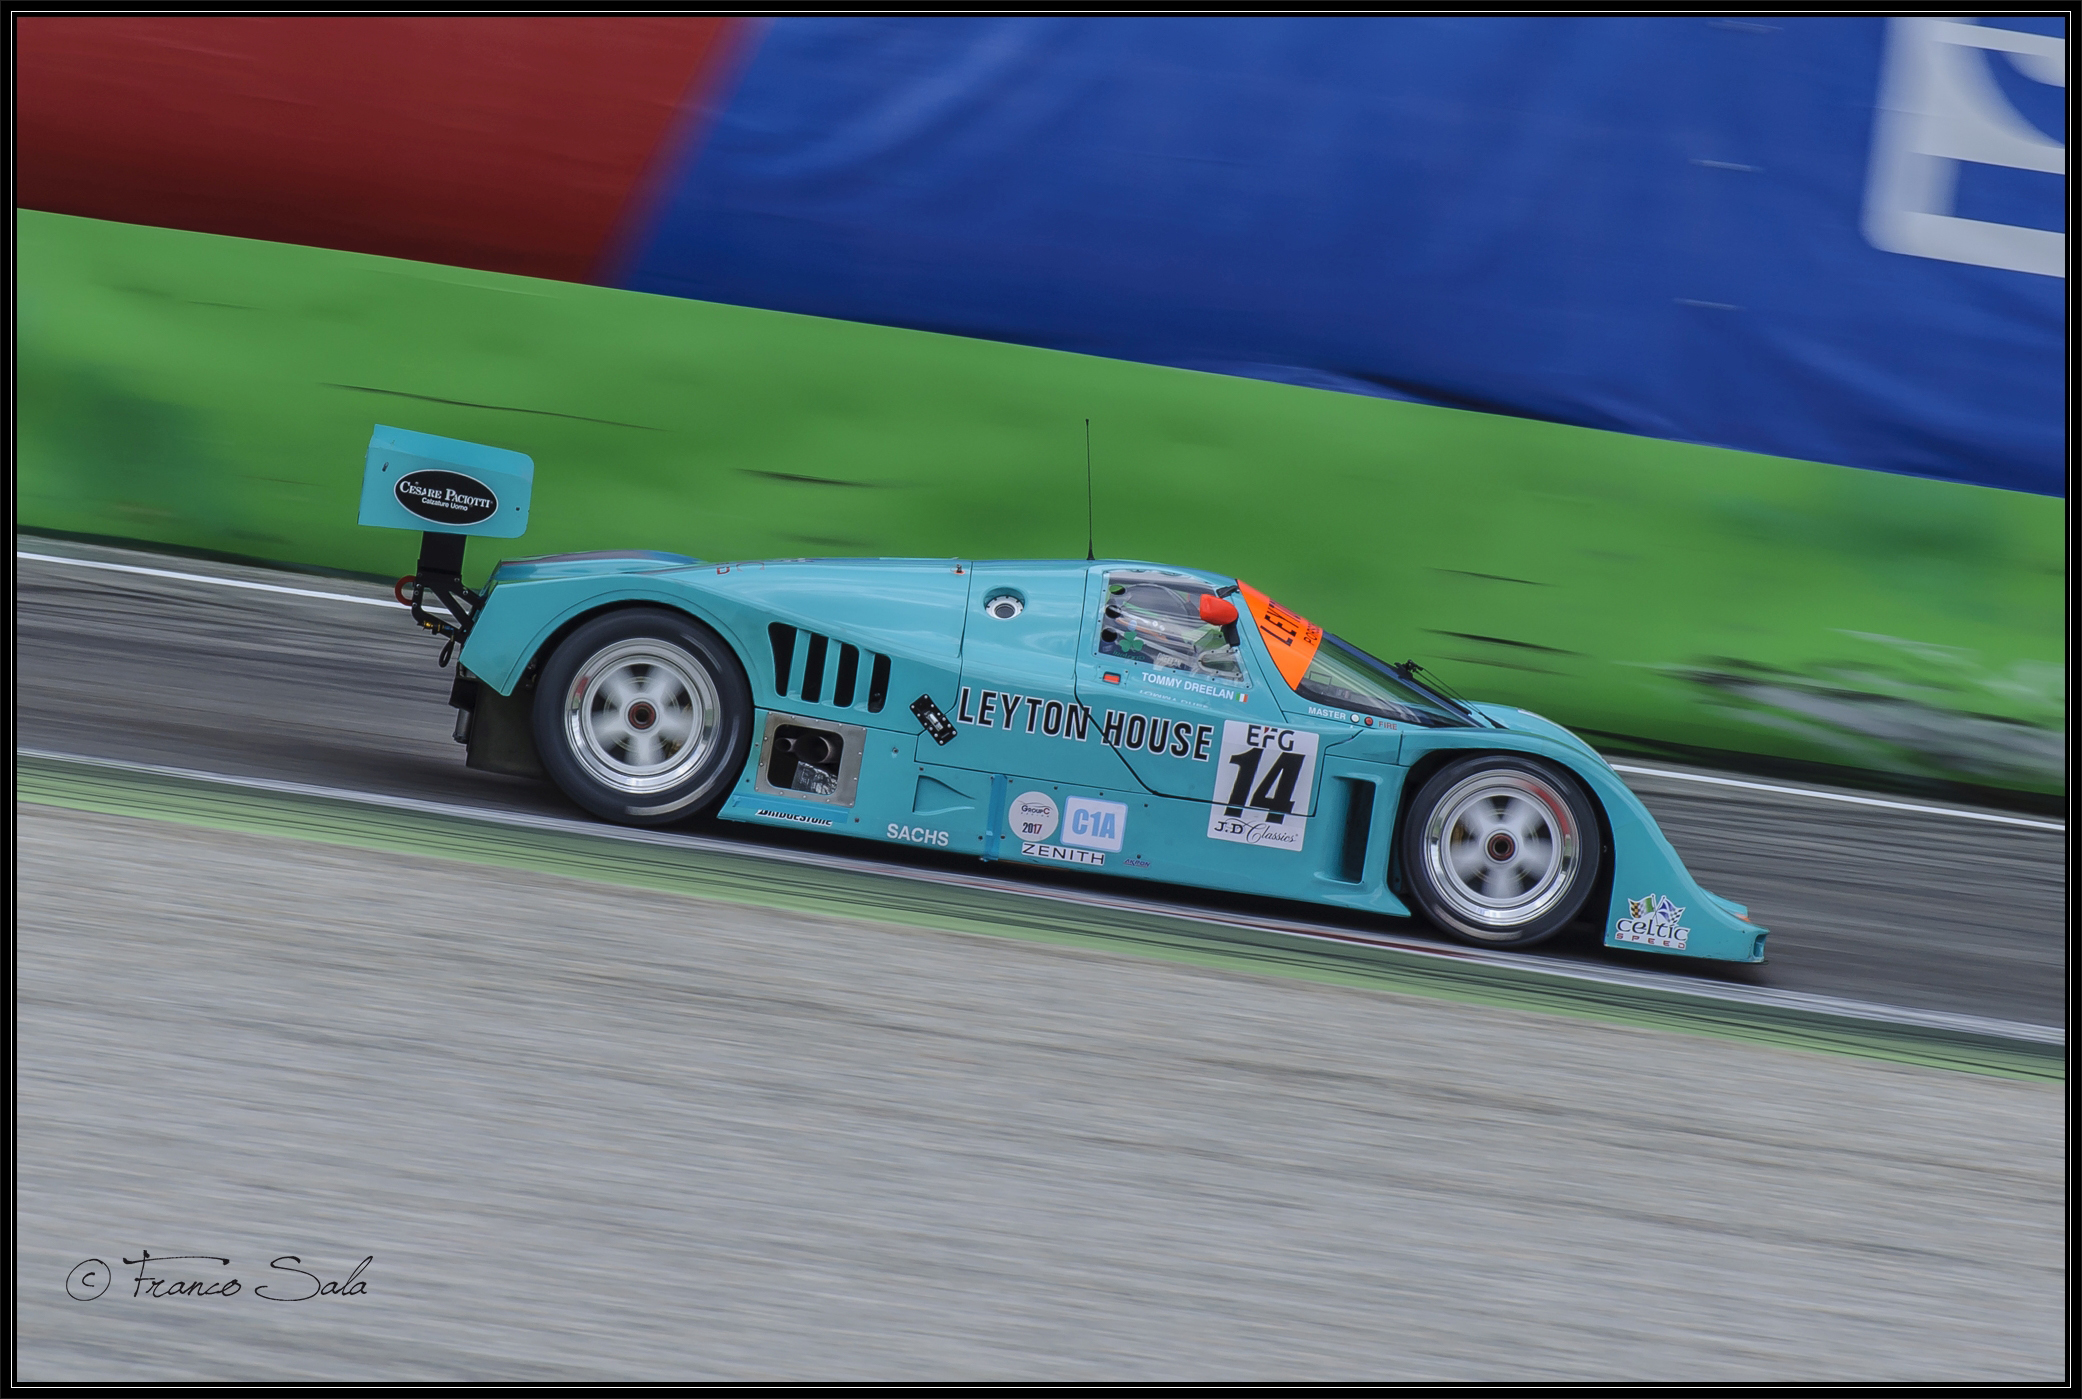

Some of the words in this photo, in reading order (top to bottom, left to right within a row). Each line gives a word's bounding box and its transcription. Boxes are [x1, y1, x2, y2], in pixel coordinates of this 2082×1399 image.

[421, 497, 449, 508] Calzature
[450, 502, 468, 511] Uomo
[444, 488, 491, 509] PACIOTTI
[1142, 672, 1182, 688] TOMMY
[1184, 681, 1234, 700] DREELAN
[957, 686, 1091, 741] LEYTON
[1101, 708, 1214, 762] HOUSE
[1308, 706, 1346, 720] MASTER
[1378, 721, 1397, 730] FIRE
[1246, 724, 1295, 751] EFG
[1224, 747, 1306, 825] 14
[886, 823, 949, 847] SACHS
[1022, 822, 1042, 834] 2017
[1071, 808, 1116, 839] C1A
[1243, 822, 1297, 844] Classics
[1022, 843, 1105, 865] ZENITH
[1615, 932, 1686, 949] SPEED
